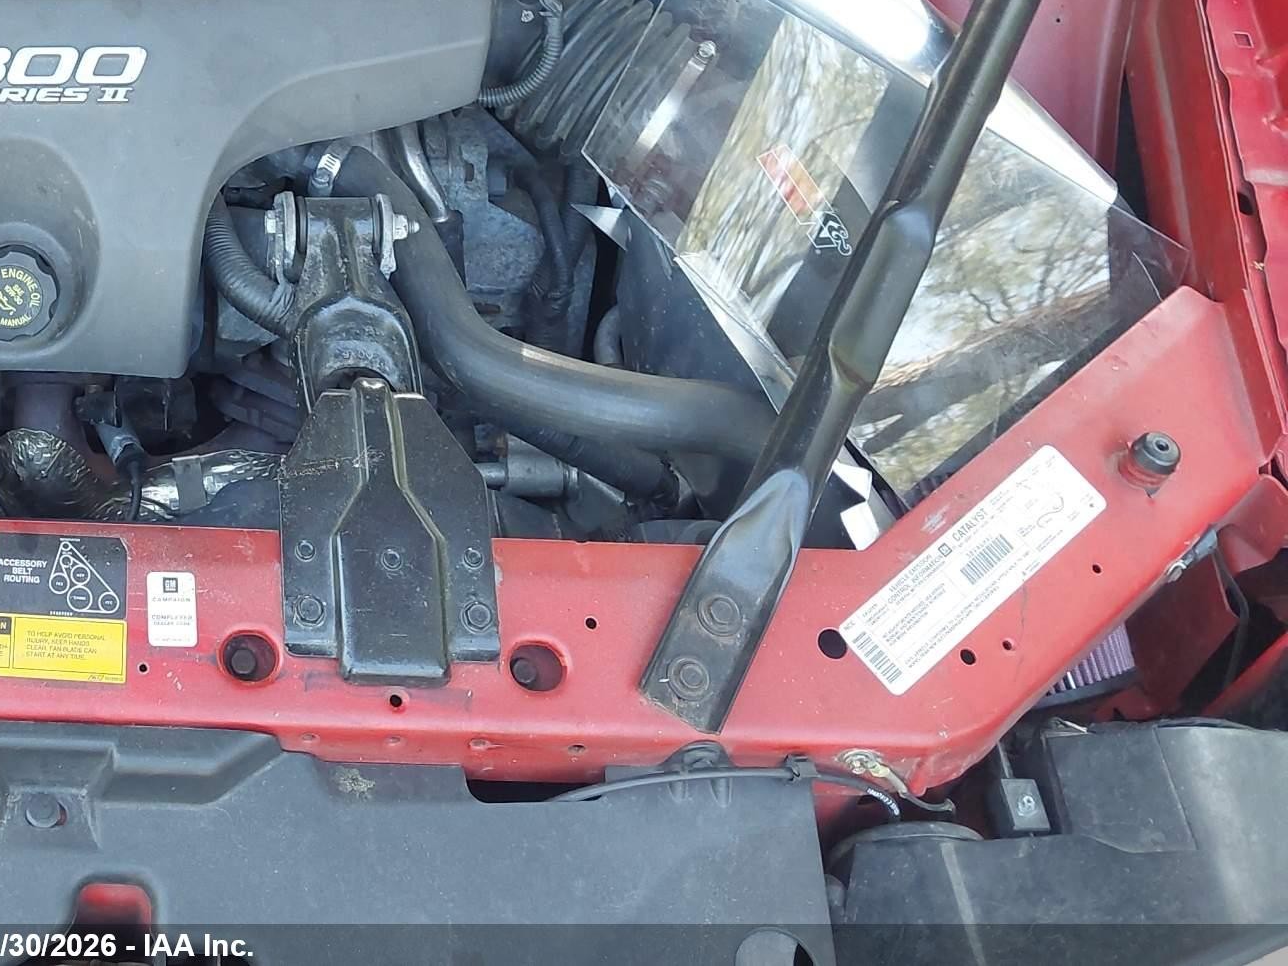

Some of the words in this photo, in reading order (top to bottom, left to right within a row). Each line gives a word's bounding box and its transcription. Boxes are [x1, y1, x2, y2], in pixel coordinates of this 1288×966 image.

[97, 87, 134, 102] II
[1, 268, 38, 292] ENGINE
[29, 292, 41, 308] OIL
[0, 313, 32, 327] MANUAL
[950, 507, 989, 542] CATALYST
[12, 566, 33, 575] BELT
[4, 574, 41, 584] ROUTING
